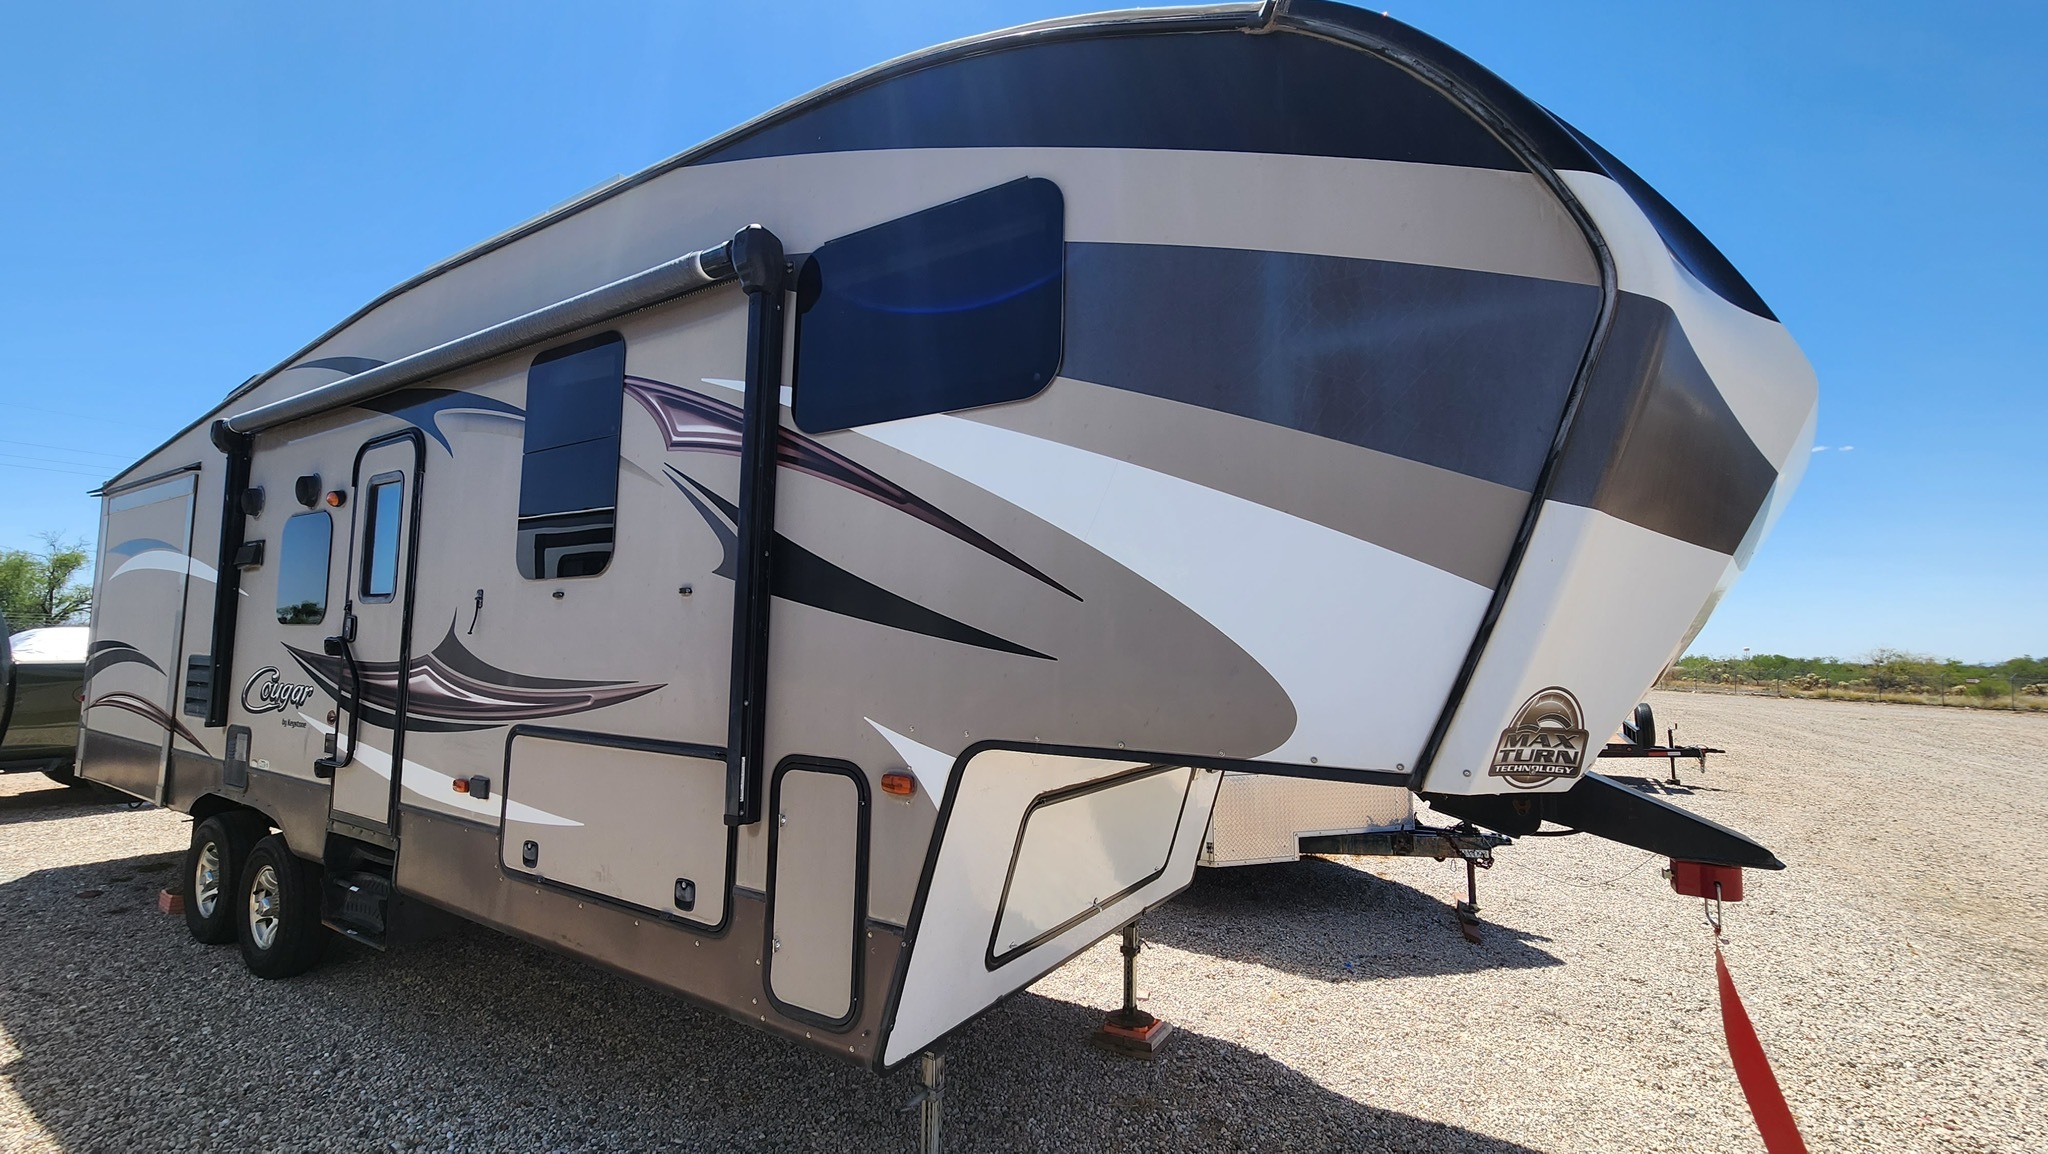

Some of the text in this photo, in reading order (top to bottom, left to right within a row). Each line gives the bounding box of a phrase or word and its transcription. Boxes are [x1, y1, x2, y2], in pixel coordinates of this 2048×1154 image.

[241, 666, 314, 714] Cougar
[281, 718, 287, 728] by
[1503, 733, 1579, 749] MAX
[1499, 748, 1579, 765] TURN
[1495, 765, 1574, 774] TECHNOLOGY
